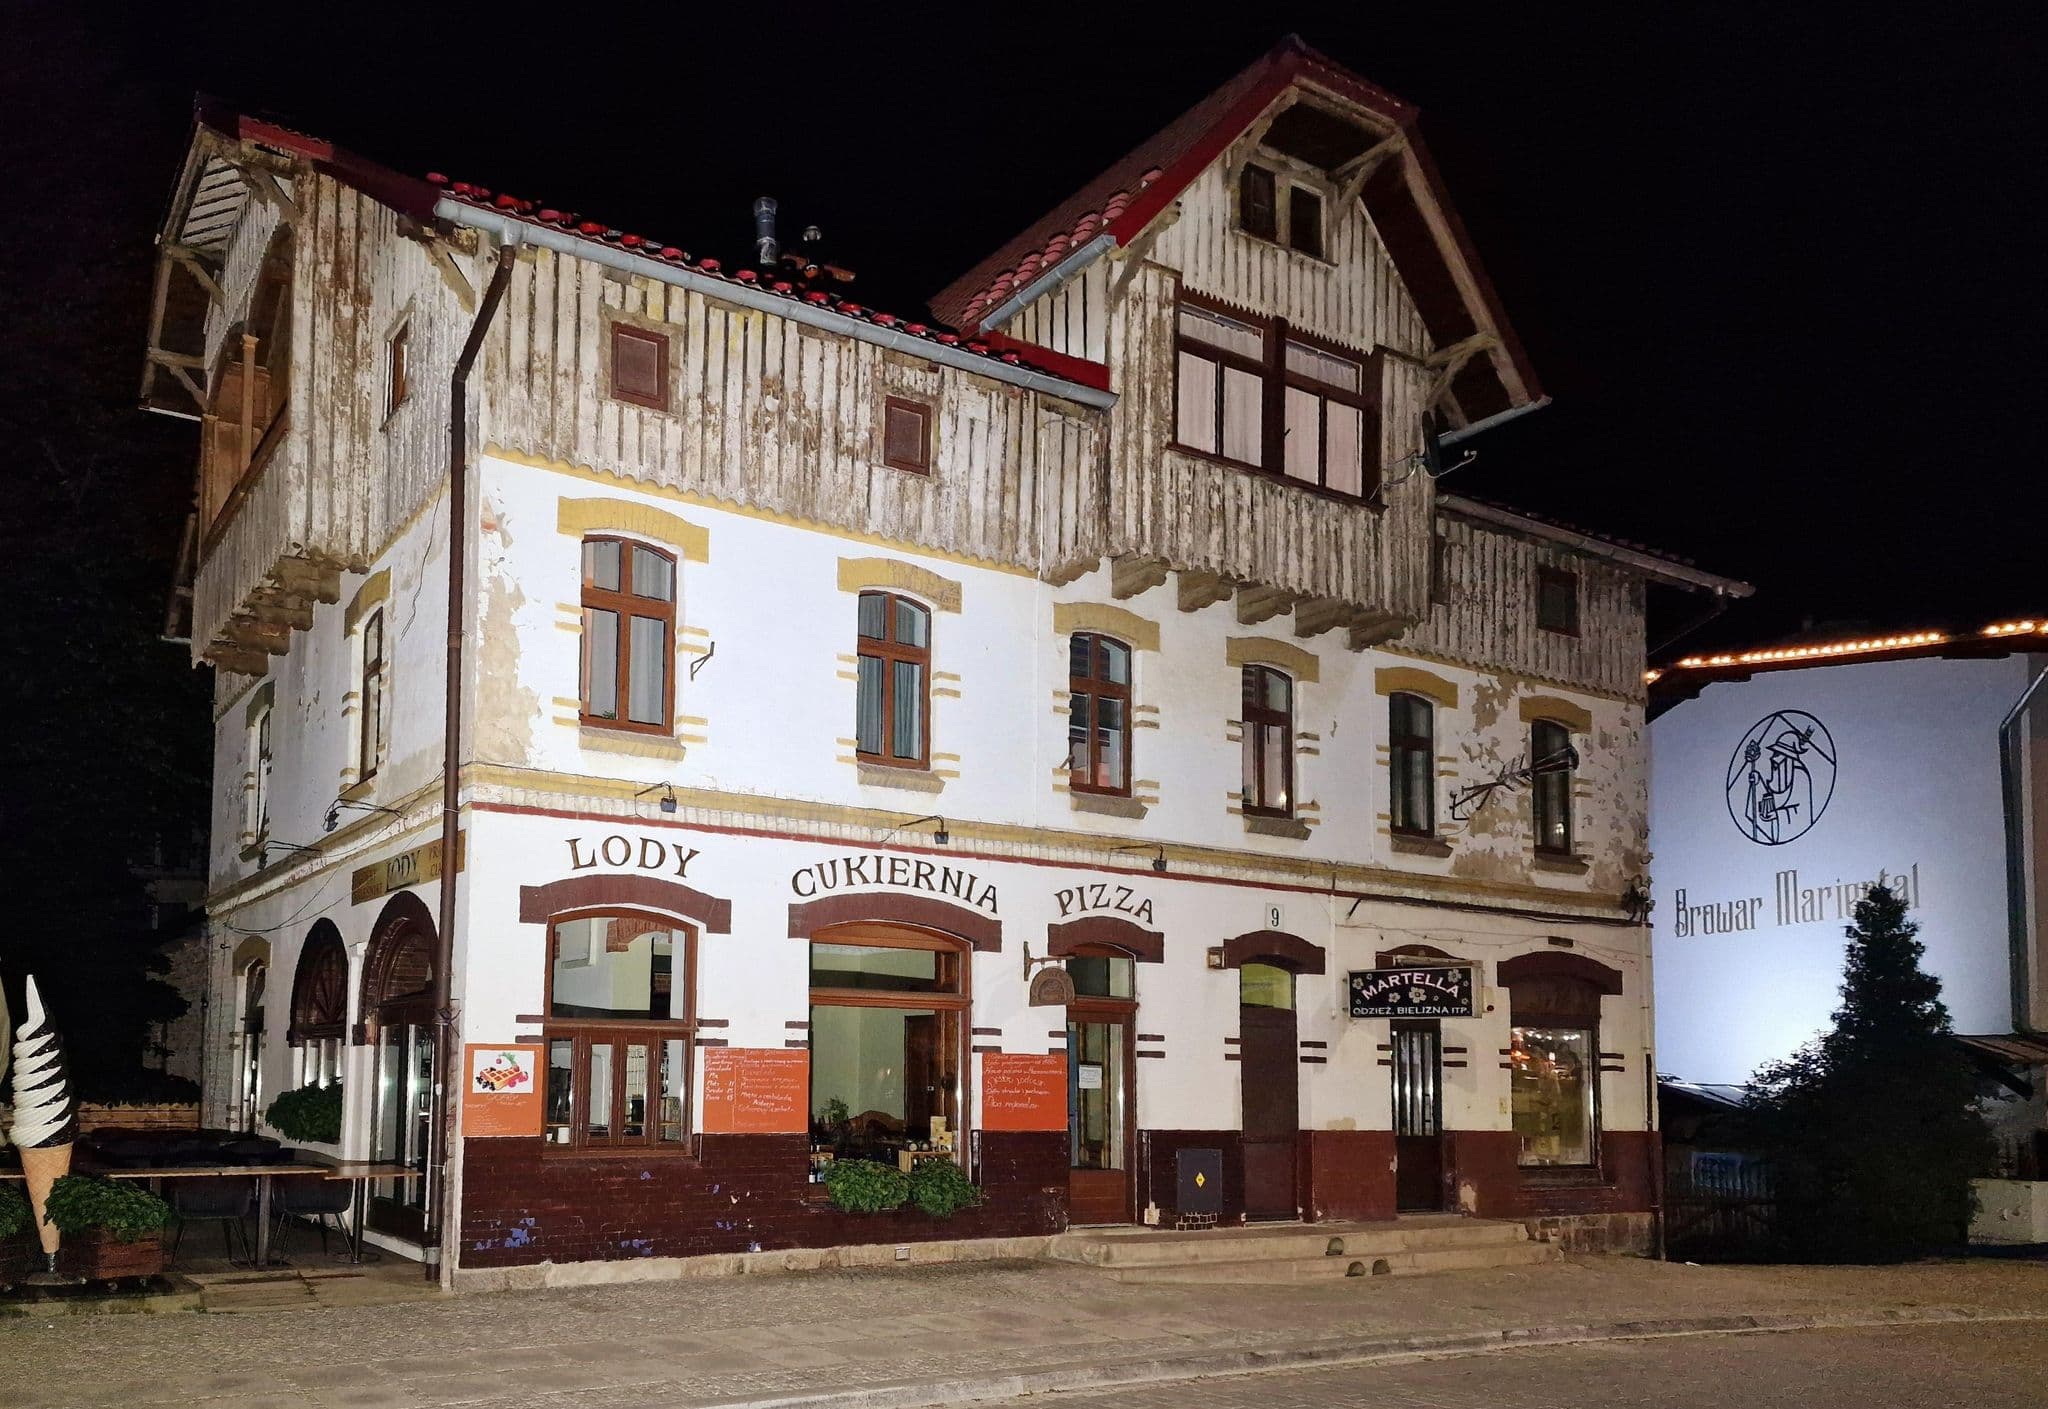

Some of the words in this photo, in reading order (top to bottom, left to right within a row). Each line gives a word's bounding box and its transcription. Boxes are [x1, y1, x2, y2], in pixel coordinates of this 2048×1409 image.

[565, 835, 700, 878] LODY
[791, 855, 999, 914] CUKIERNIA
[1054, 883, 1154, 924] PIZZA
[1270, 907, 1280, 927] 9
[1674, 888, 1763, 938] Browar
[1361, 972, 1459, 1001] MARTELLA
[1397, 1006, 1449, 1015] BIELIZNA
[1451, 1006, 1470, 1014] ITP.
